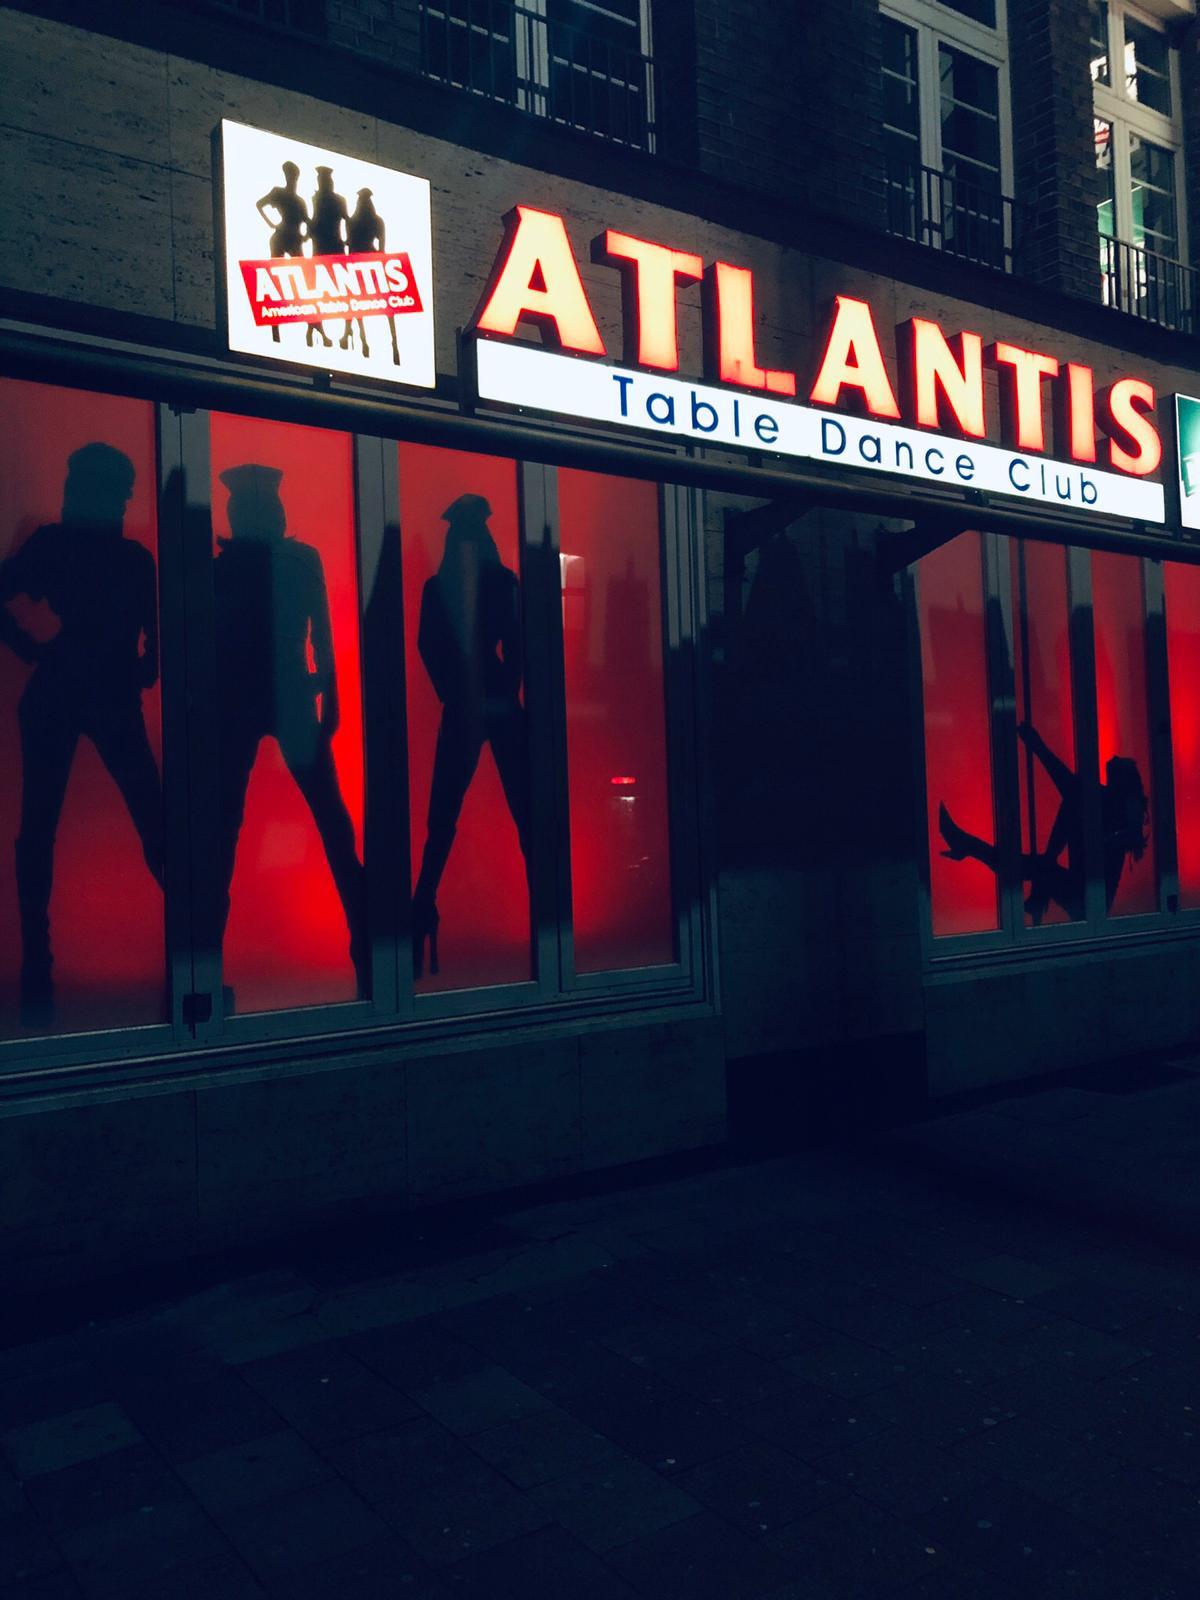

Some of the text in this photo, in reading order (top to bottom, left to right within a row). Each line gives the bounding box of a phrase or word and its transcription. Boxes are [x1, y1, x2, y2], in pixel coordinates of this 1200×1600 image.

[255, 258, 409, 302] ATLANTIS
[261, 304, 317, 318] American
[388, 295, 415, 308] Club
[475, 204, 1163, 477] ATLANTIS
[612, 373, 1098, 505] Table Dance Club
